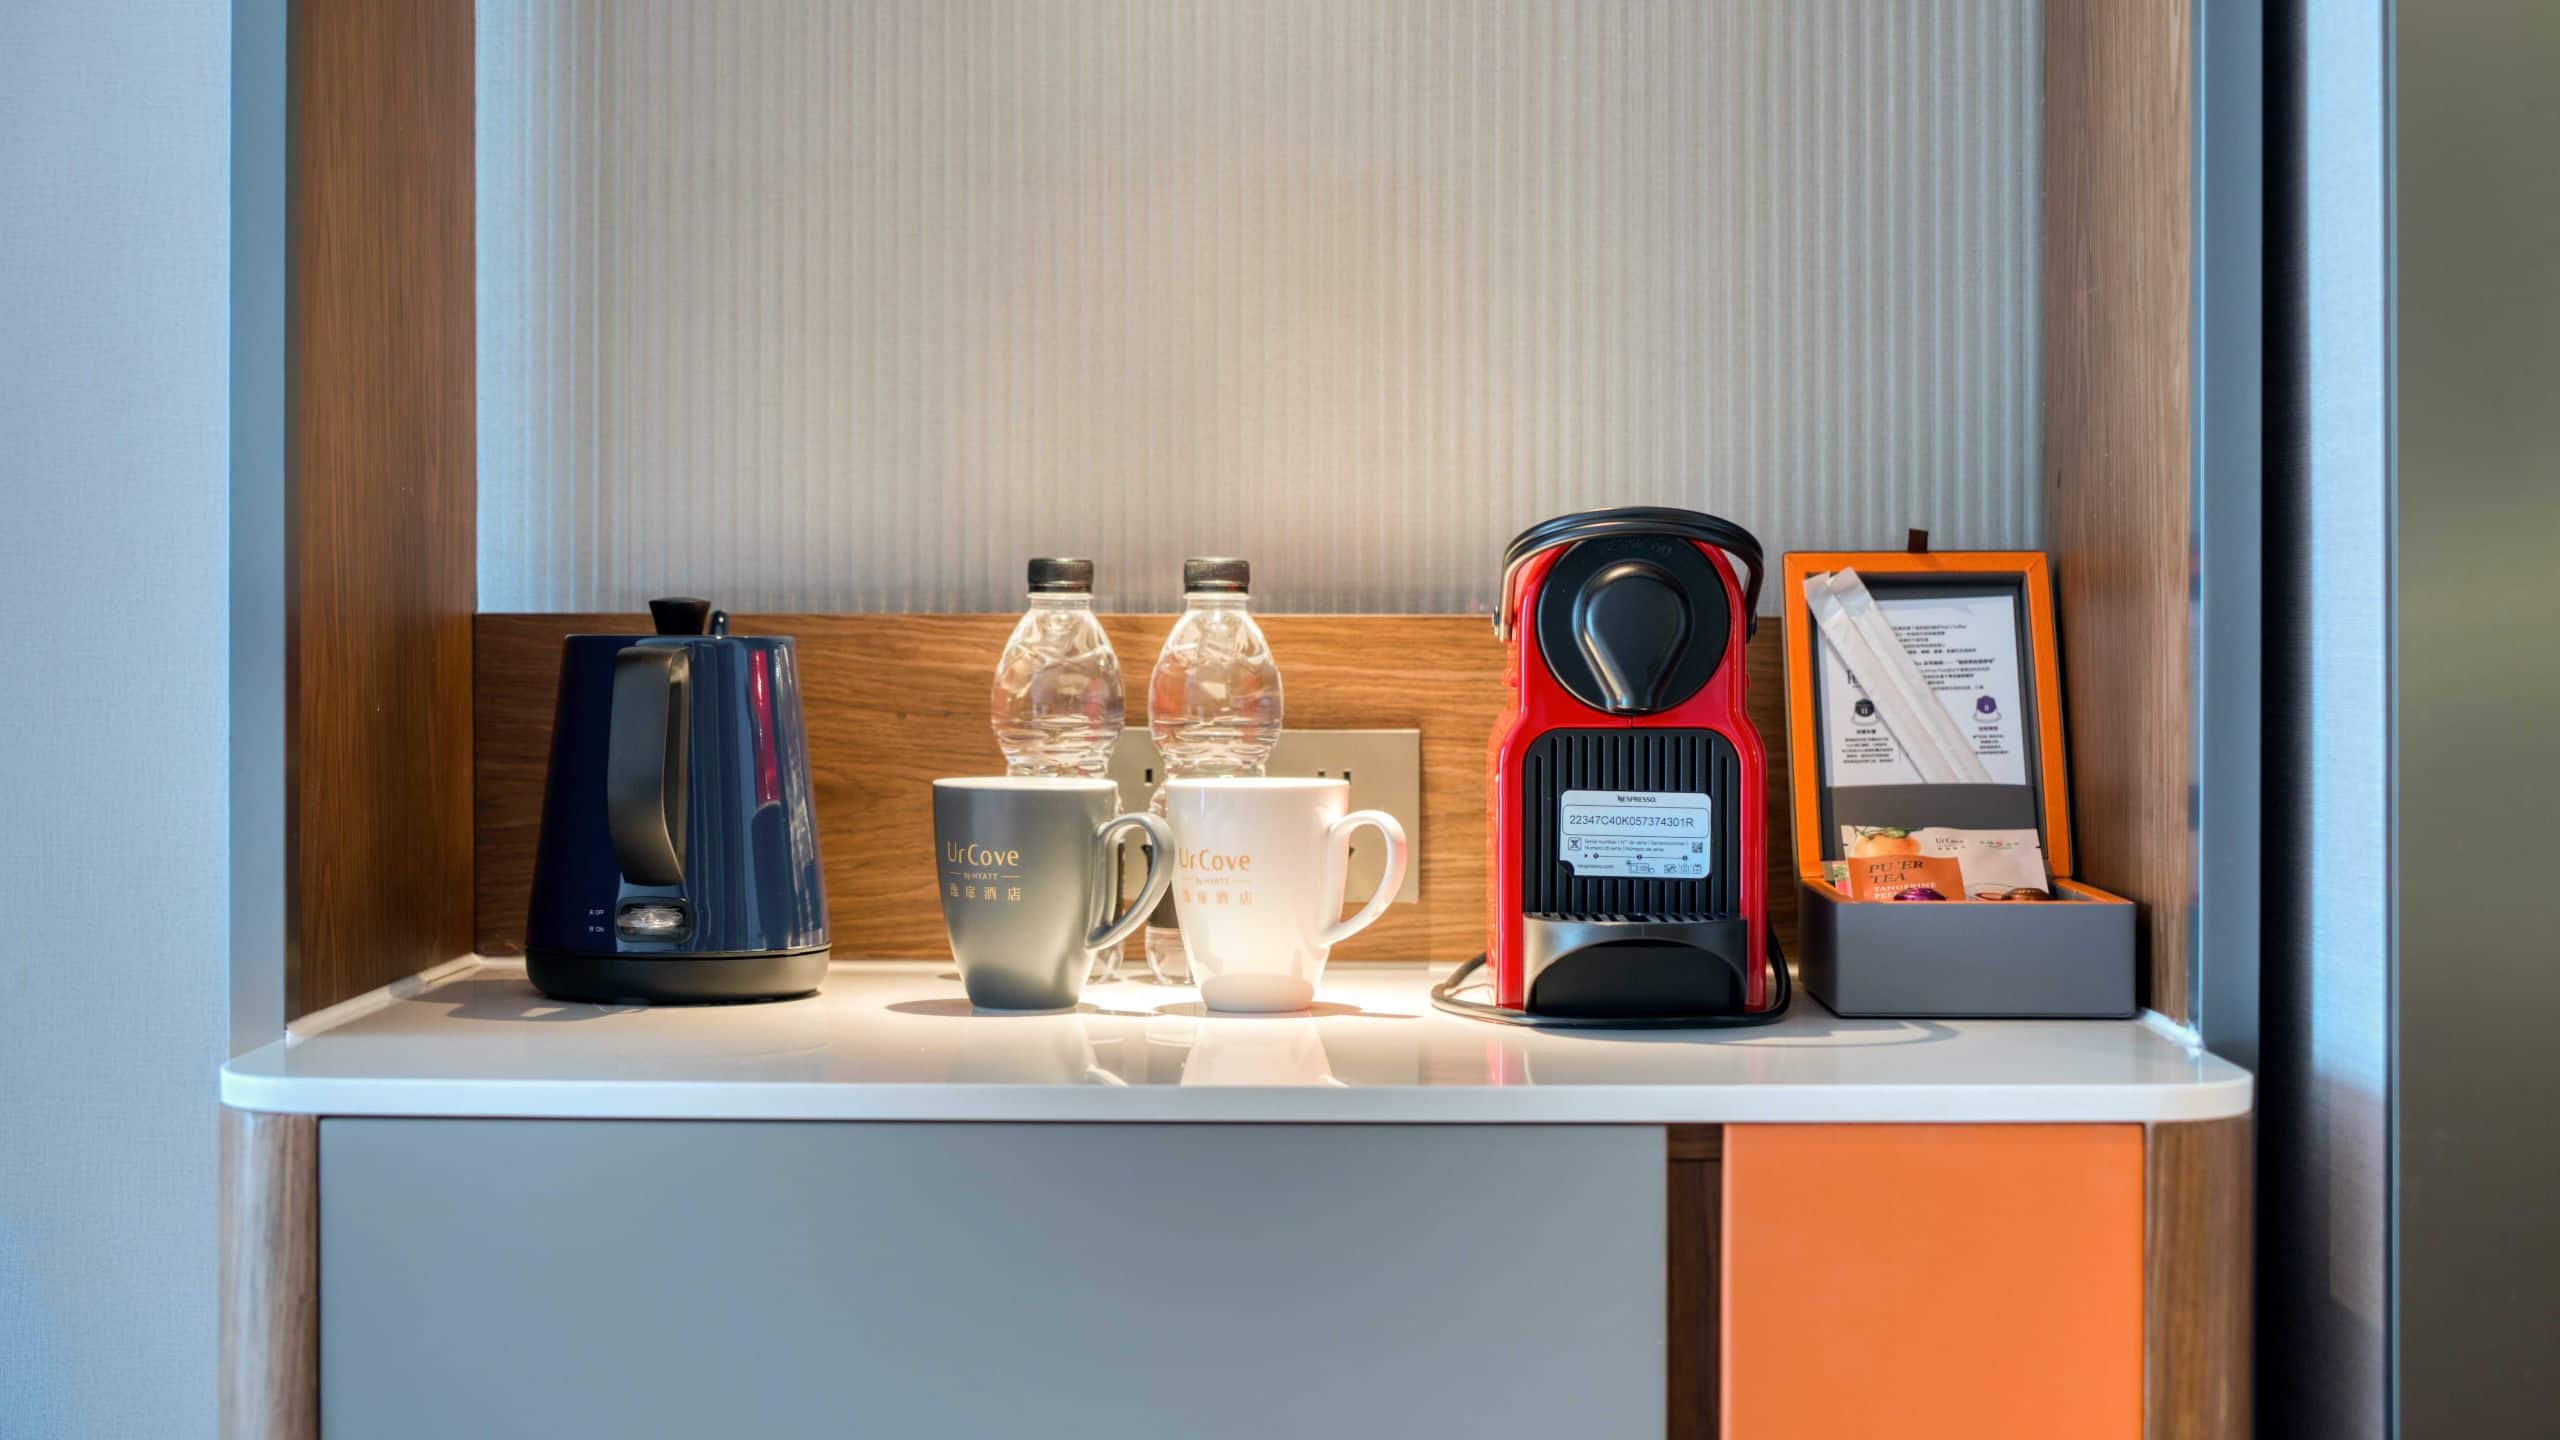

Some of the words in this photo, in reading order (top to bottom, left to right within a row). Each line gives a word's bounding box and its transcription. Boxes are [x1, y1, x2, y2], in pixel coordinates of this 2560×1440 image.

[1570, 815, 1694, 828] 22347C40K057374301R
[947, 841, 1019, 867] UrCove
[1178, 847, 1249, 872] UrCove
[1870, 872, 1905, 883] TEA
[1873, 892, 1899, 900] PEE
